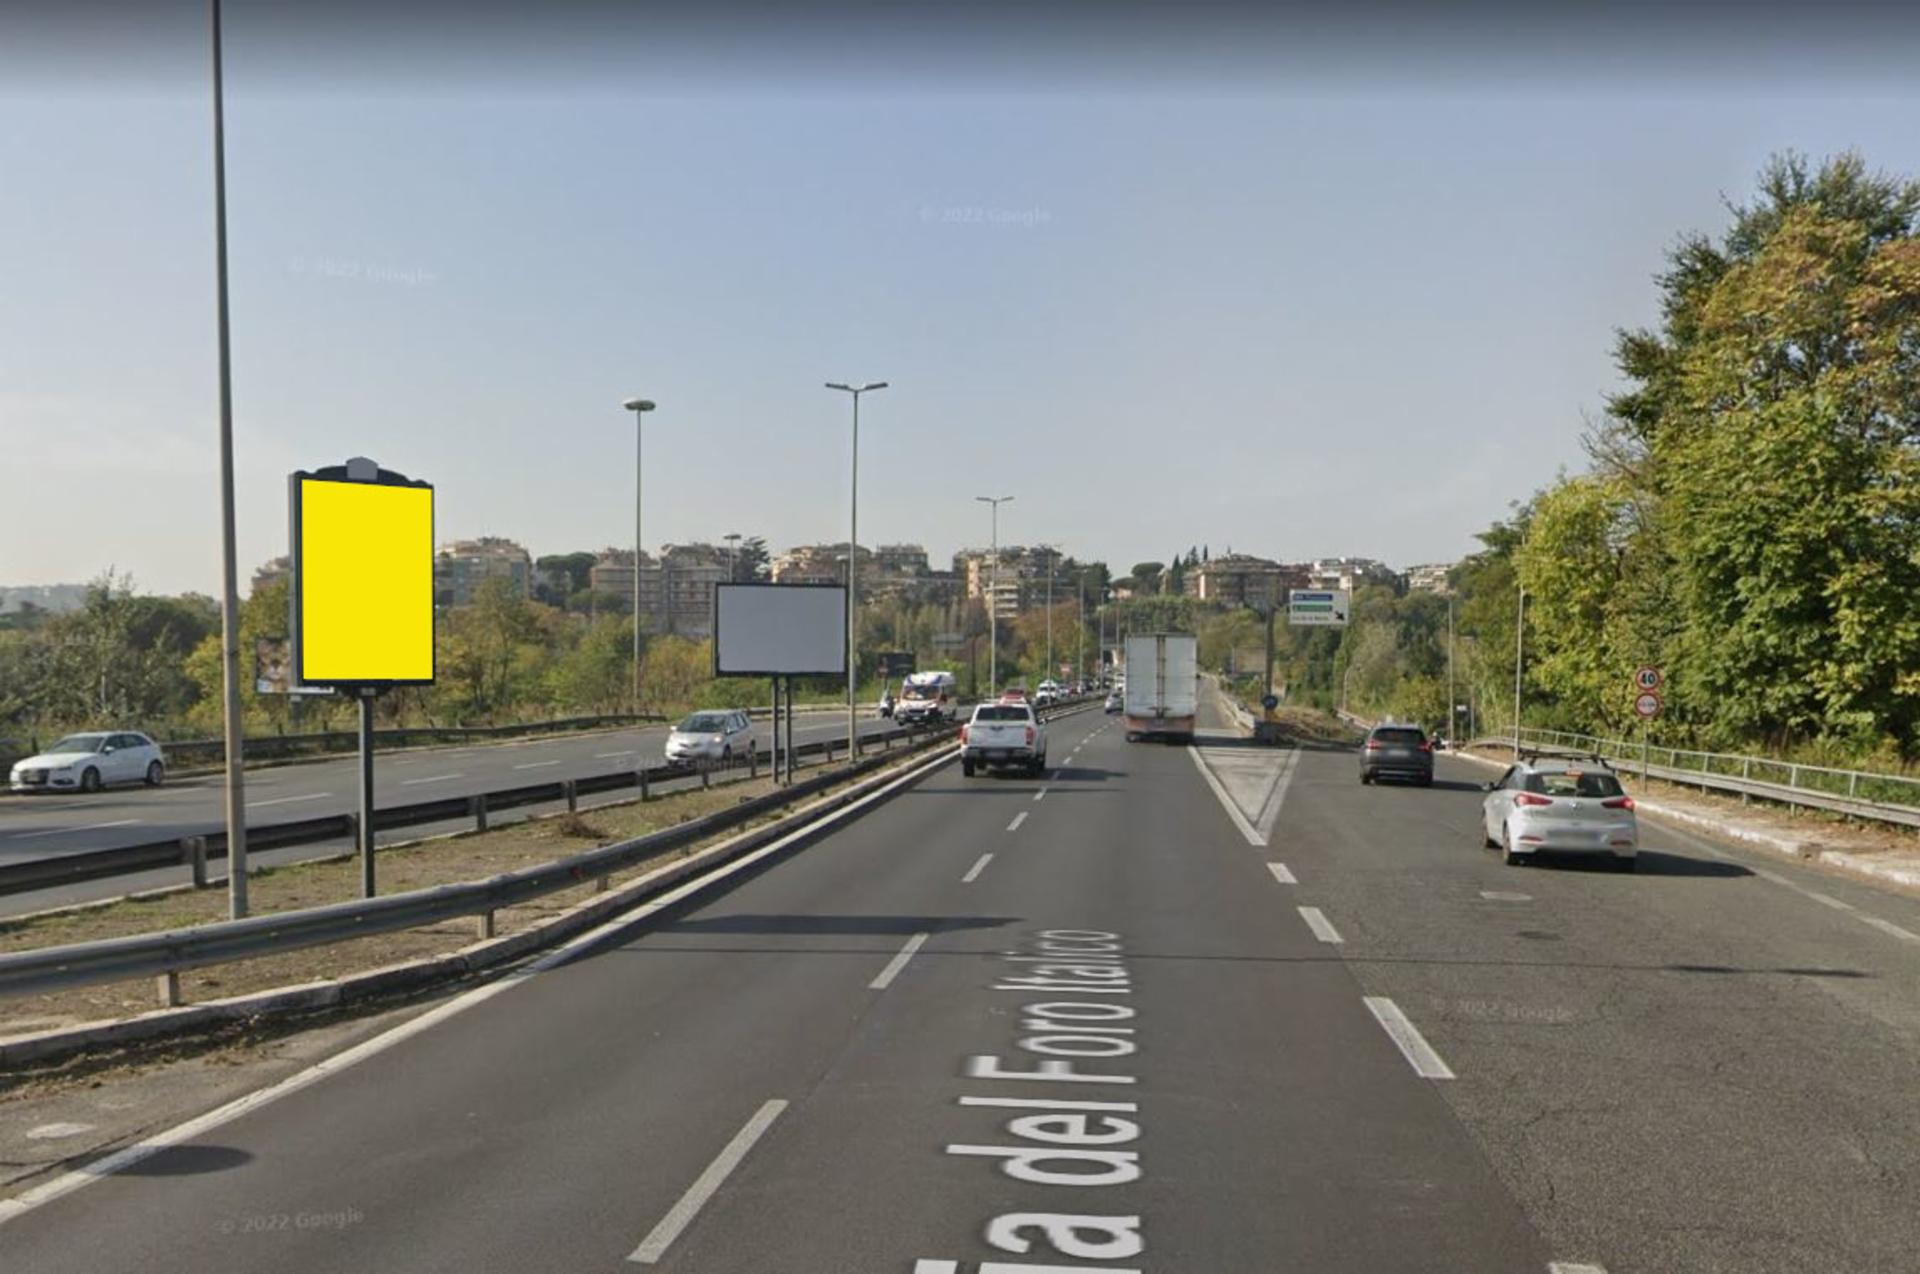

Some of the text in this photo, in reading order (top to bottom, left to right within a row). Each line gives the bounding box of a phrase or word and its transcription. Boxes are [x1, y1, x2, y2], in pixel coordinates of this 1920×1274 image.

[1641, 672, 1656, 685] 40
[993, 929, 1132, 993] Italico
[967, 1001, 1137, 1083] Foro
[945, 1096, 1143, 1186] del
